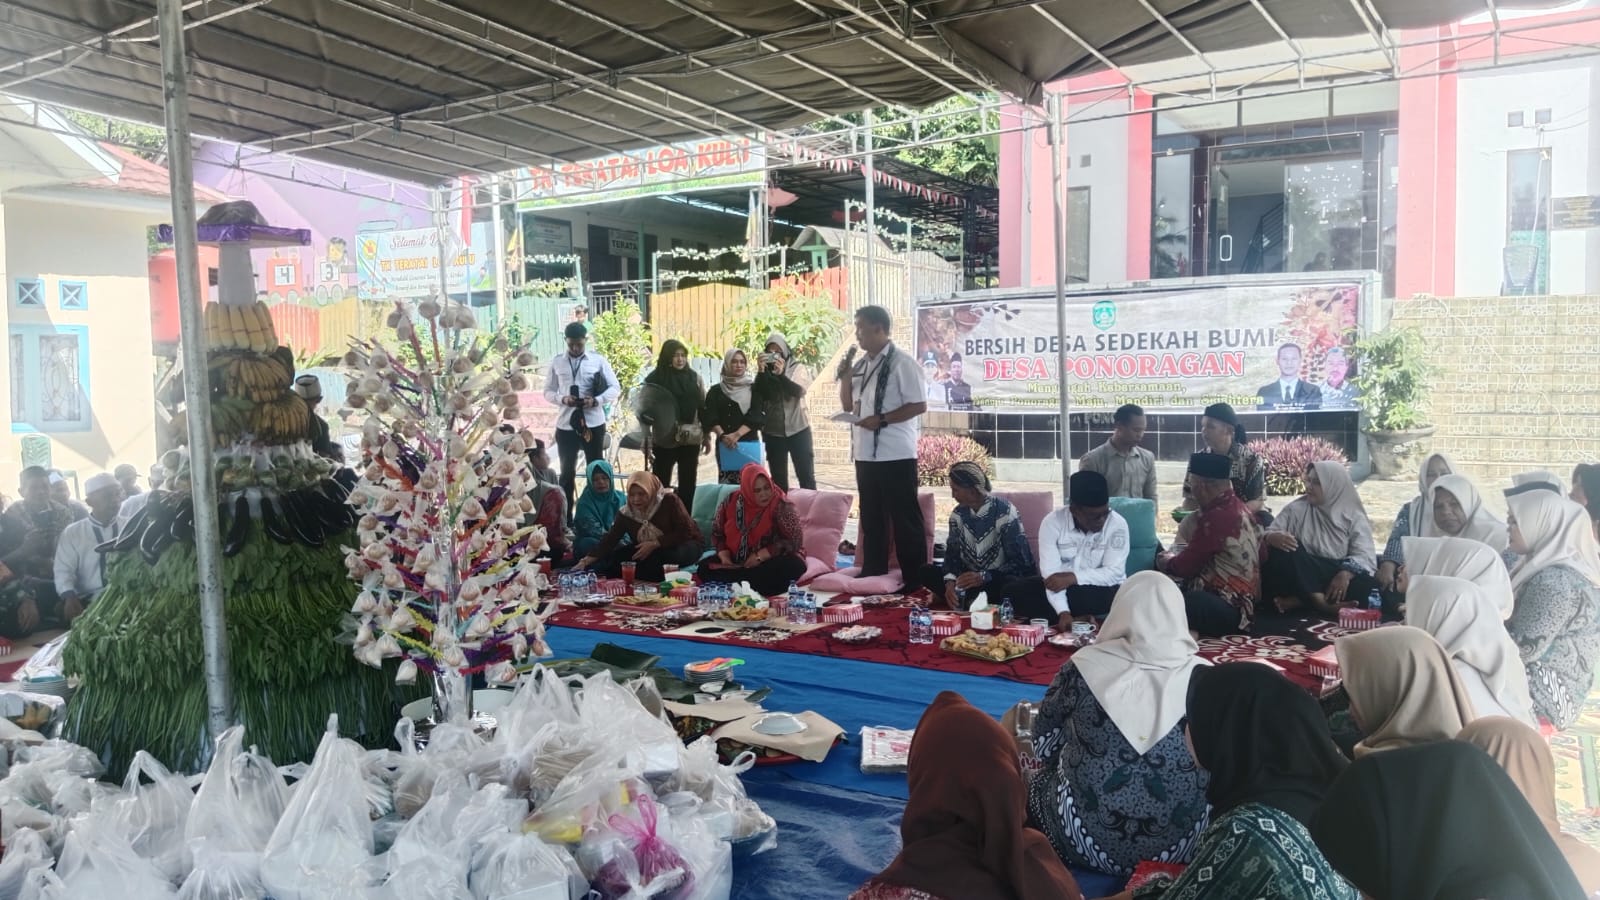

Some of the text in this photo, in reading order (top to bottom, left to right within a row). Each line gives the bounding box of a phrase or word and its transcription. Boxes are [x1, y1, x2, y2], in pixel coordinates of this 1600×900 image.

[647, 147, 689, 175] LOA
[612, 239, 639, 251] TERATA
[280, 267, 290, 283] 4
[965, 327, 1275, 356] BERSIH DESA SEDEKAH BUMI
[983, 351, 1244, 381] DESA PONORAGAN
[1115, 394, 1164, 406] Mandiri
[1170, 394, 1194, 406] dan
